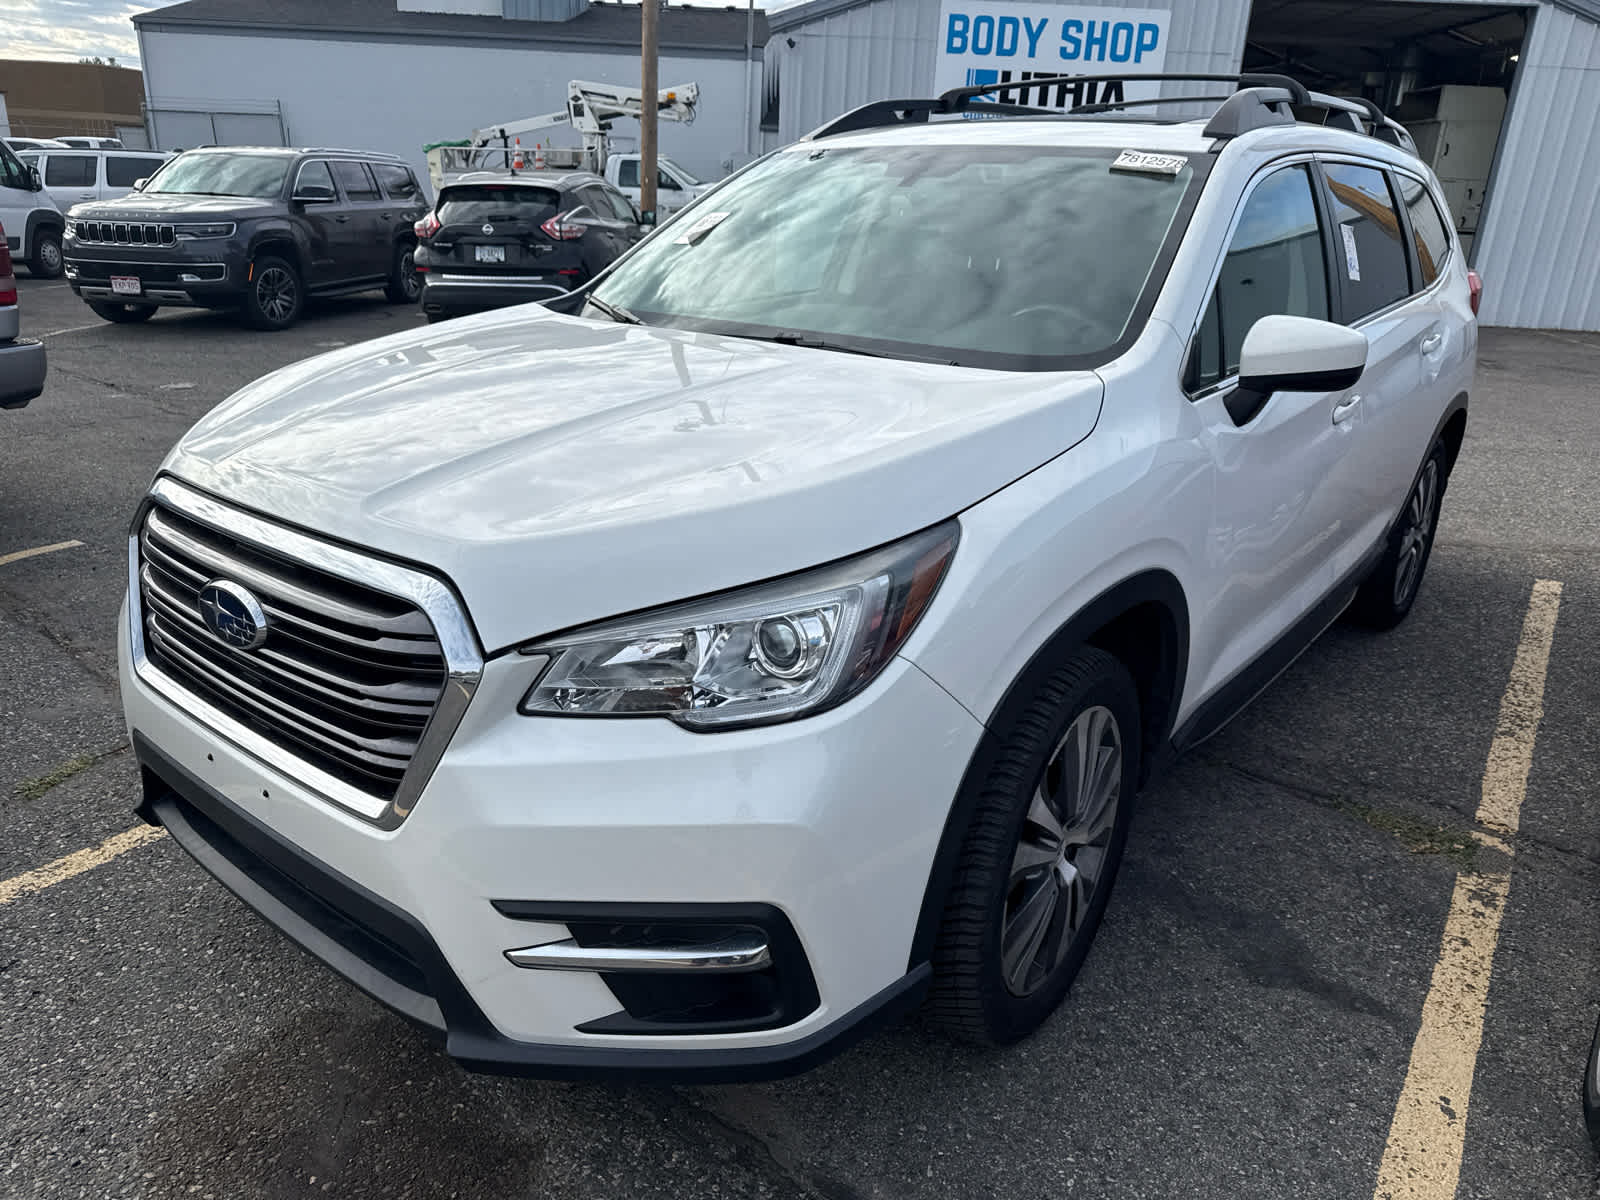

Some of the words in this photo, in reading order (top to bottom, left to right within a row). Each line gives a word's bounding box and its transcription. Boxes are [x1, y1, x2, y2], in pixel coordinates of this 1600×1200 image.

[946, 13, 1048, 58] BODY
[1059, 19, 1159, 64] SHOP
[999, 70, 1125, 111] LITHIA
